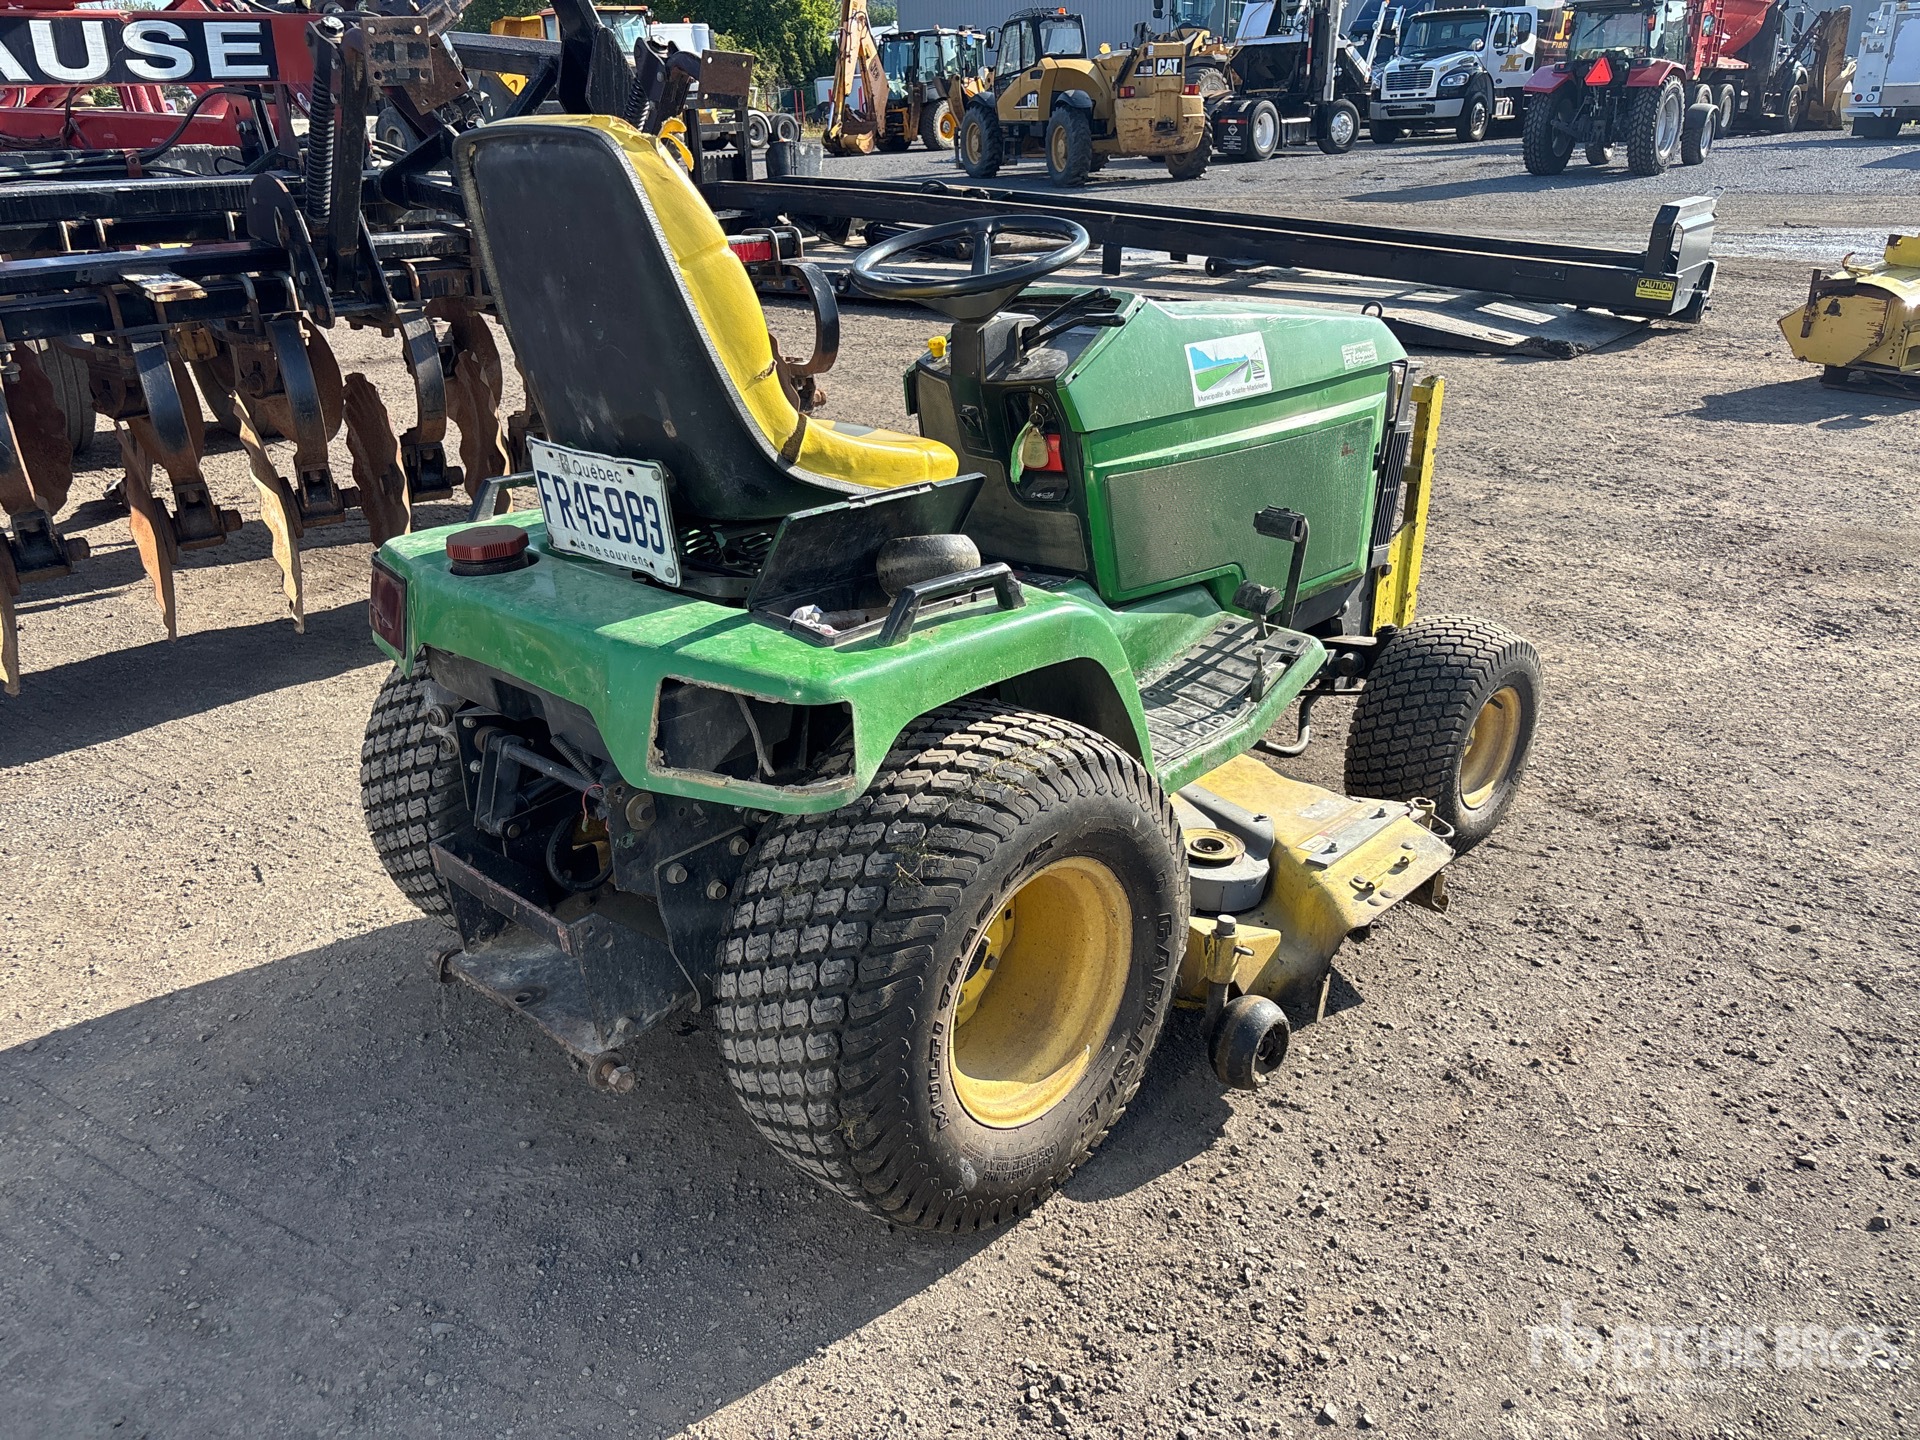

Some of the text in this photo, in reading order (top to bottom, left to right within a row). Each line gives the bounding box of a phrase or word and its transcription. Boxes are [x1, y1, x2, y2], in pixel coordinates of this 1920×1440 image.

[1157, 58, 1180, 76] CAT
[1027, 93, 1038, 108] CAT
[1639, 280, 1674, 291] CAUTION
[572, 460, 623, 485] Québec
[536, 469, 666, 555] FR45983
[588, 544, 601, 555] me
[604, 547, 650, 568] souviens
[938, 892, 994, 1012] TRAC
[1077, 912, 1173, 1139] CARLISLE
[927, 1020, 951, 1133] MULTI
